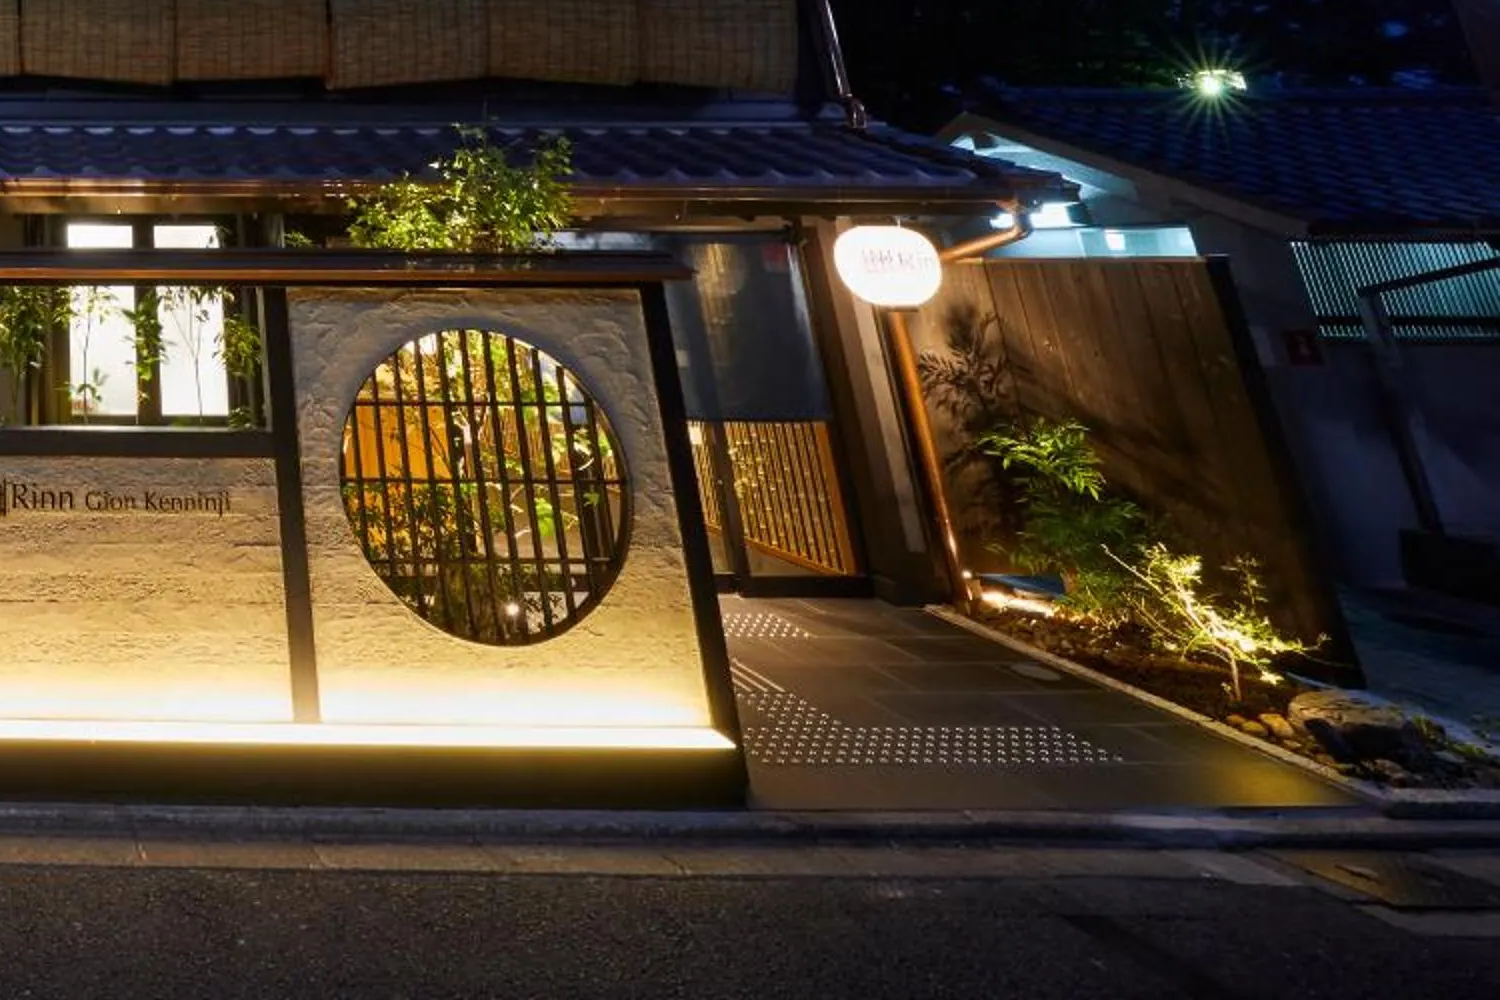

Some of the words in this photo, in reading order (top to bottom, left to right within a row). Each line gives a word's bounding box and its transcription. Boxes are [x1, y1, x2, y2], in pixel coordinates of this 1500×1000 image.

[11, 483, 73, 510] Rinn
[85, 490, 135, 511] Gion
[145, 490, 230, 517] Kenninji
